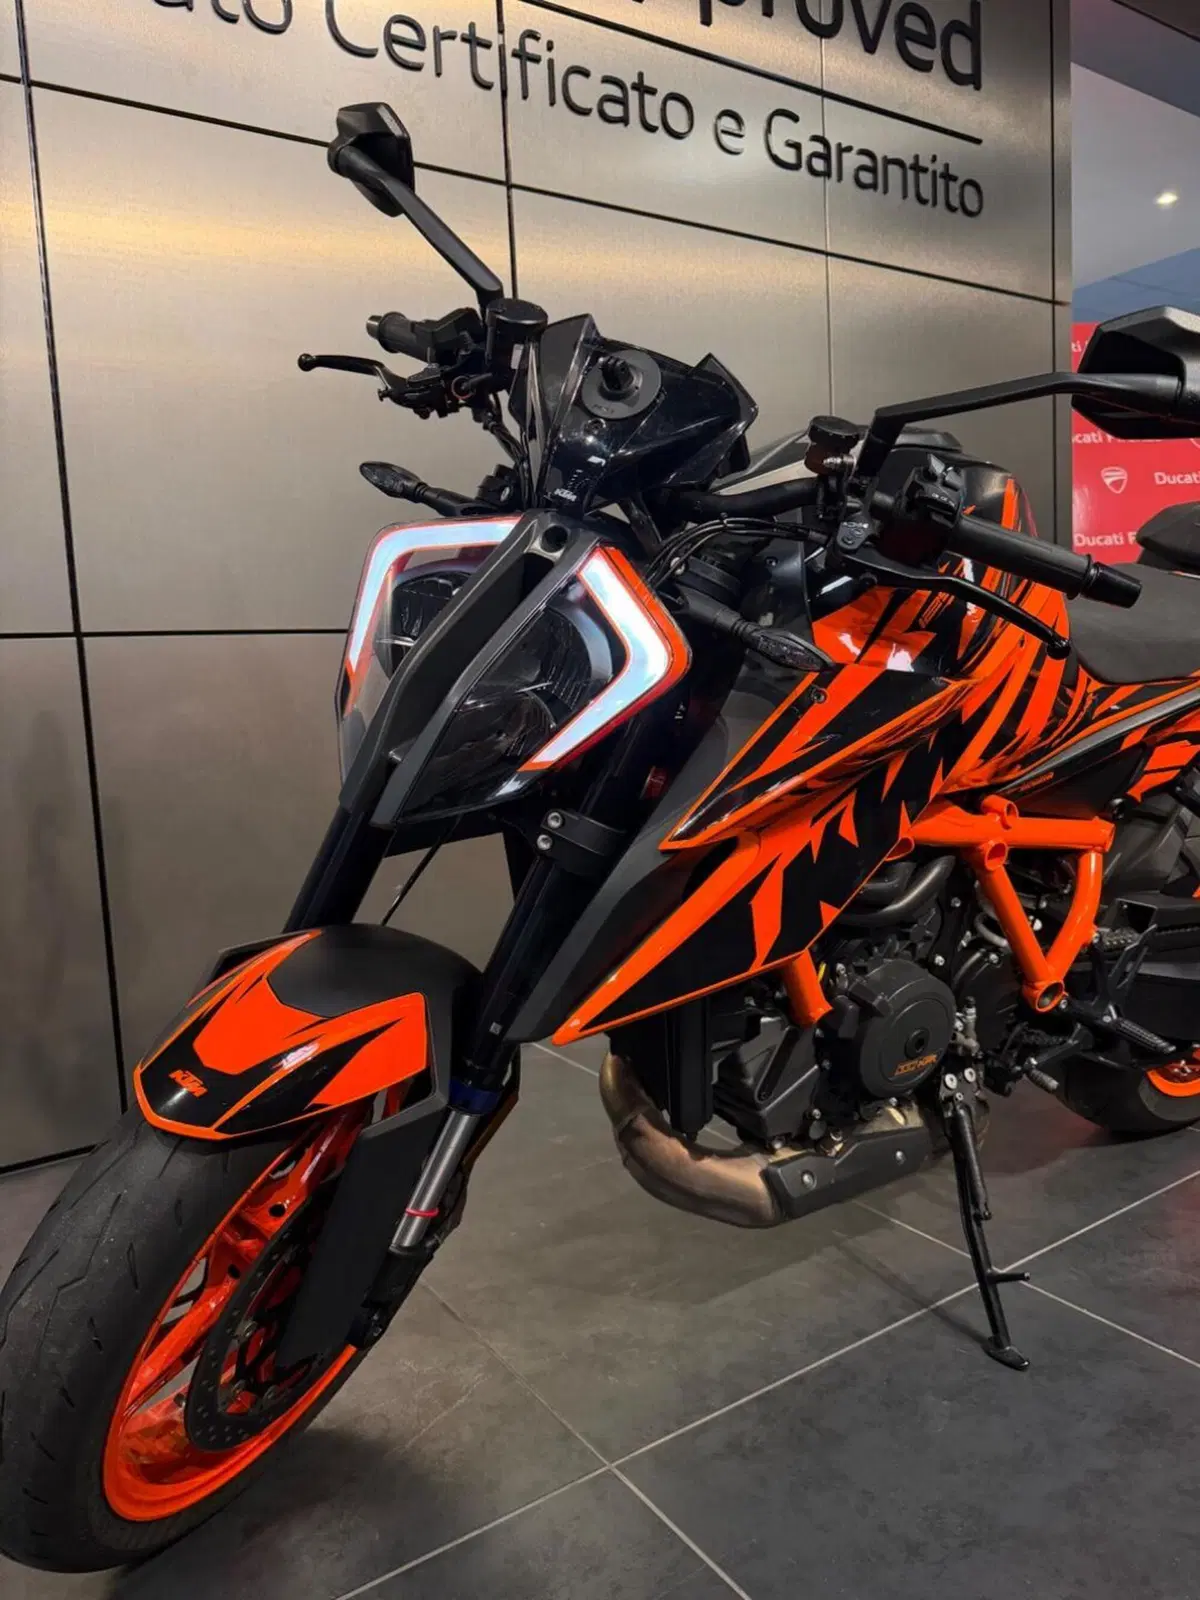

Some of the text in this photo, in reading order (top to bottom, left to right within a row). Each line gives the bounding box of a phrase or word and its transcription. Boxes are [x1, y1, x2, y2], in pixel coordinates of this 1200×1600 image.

[325, 0, 984, 218] Certificato e Garantito
[1072, 431, 1103, 444] cati
[1074, 532, 1124, 547] Ducati
[169, 1069, 208, 1097] KTM
